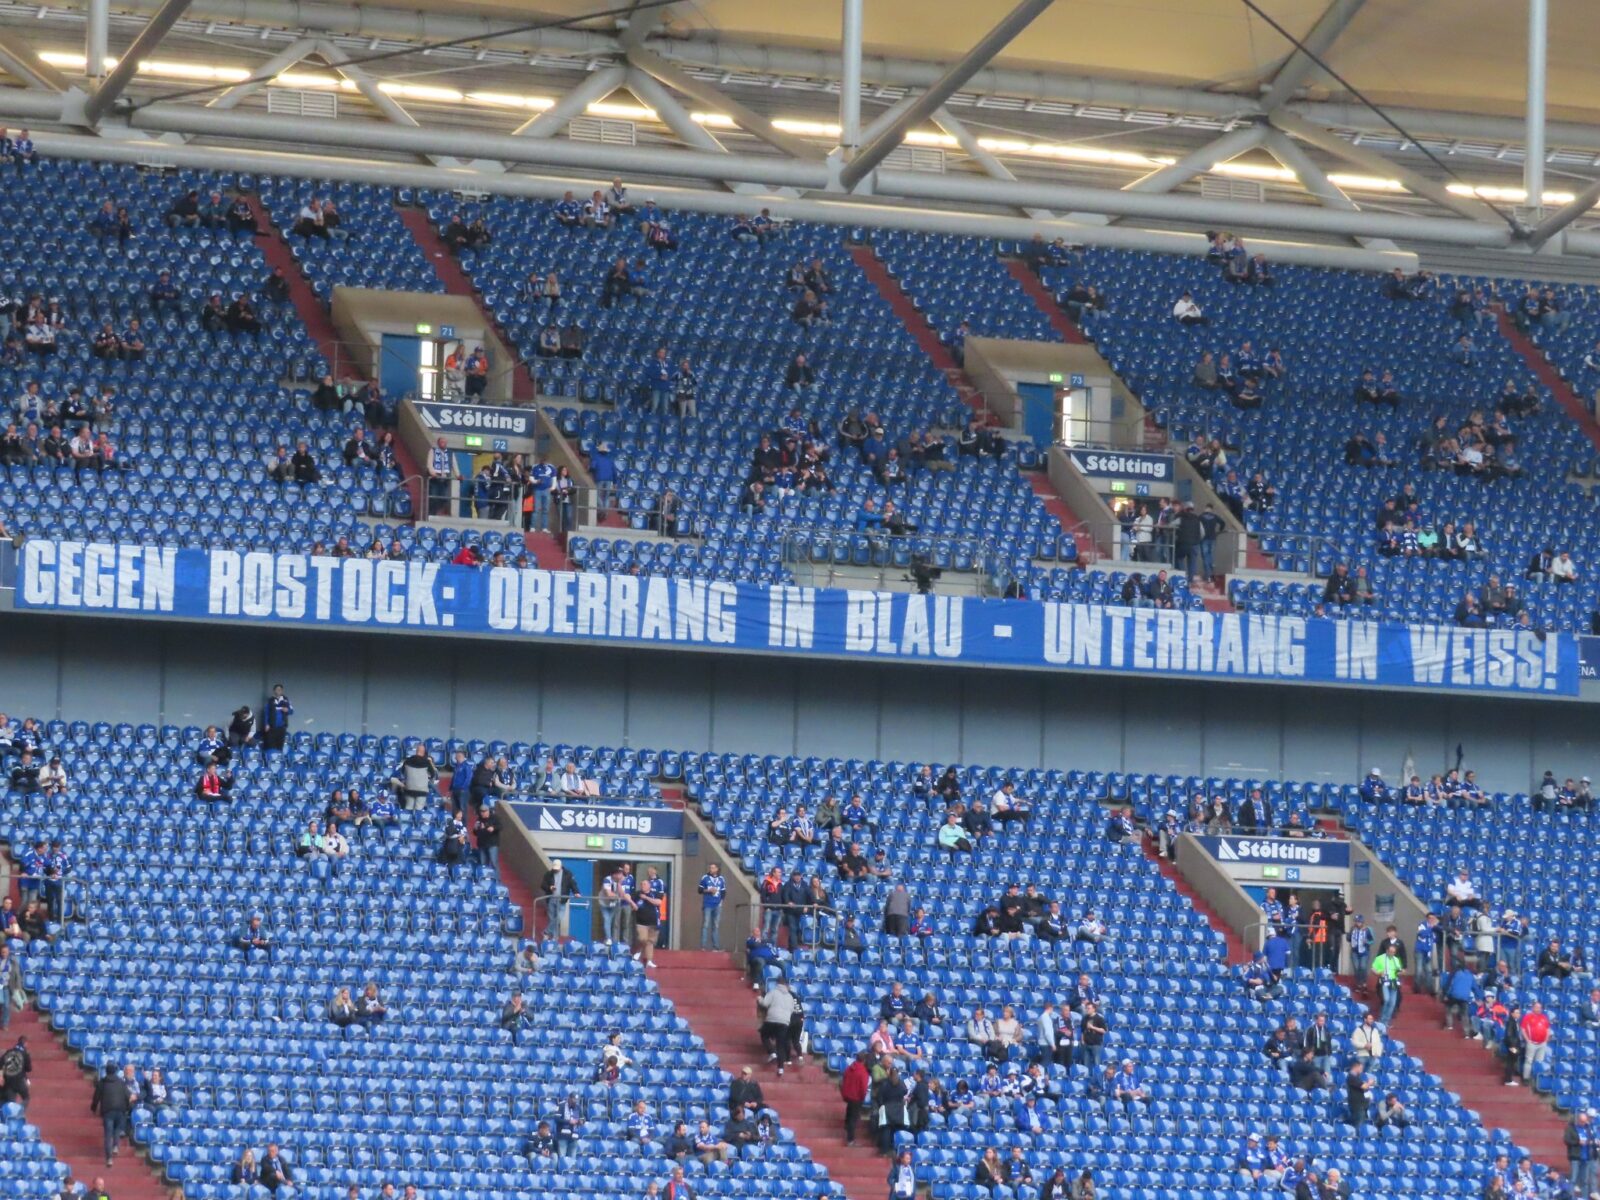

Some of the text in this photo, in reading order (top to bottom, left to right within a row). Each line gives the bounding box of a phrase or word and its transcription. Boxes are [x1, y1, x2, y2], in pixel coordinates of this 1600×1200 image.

[442, 327, 453, 337] 71
[1071, 376, 1083, 385] 73
[440, 409, 526, 433] Stölting
[495, 440, 506, 450] 72
[1086, 455, 1166, 478] Stölting
[1137, 485, 1148, 494] 74
[24, 539, 1558, 690] GEGEN ROSTOCK: OBERRANG IN BLAU - UNTERRANG IN WEISS!
[561, 809, 652, 833] Stölting
[614, 840, 625, 850] S3
[1238, 840, 1320, 863] Stölting
[1287, 870, 1298, 880] S4
